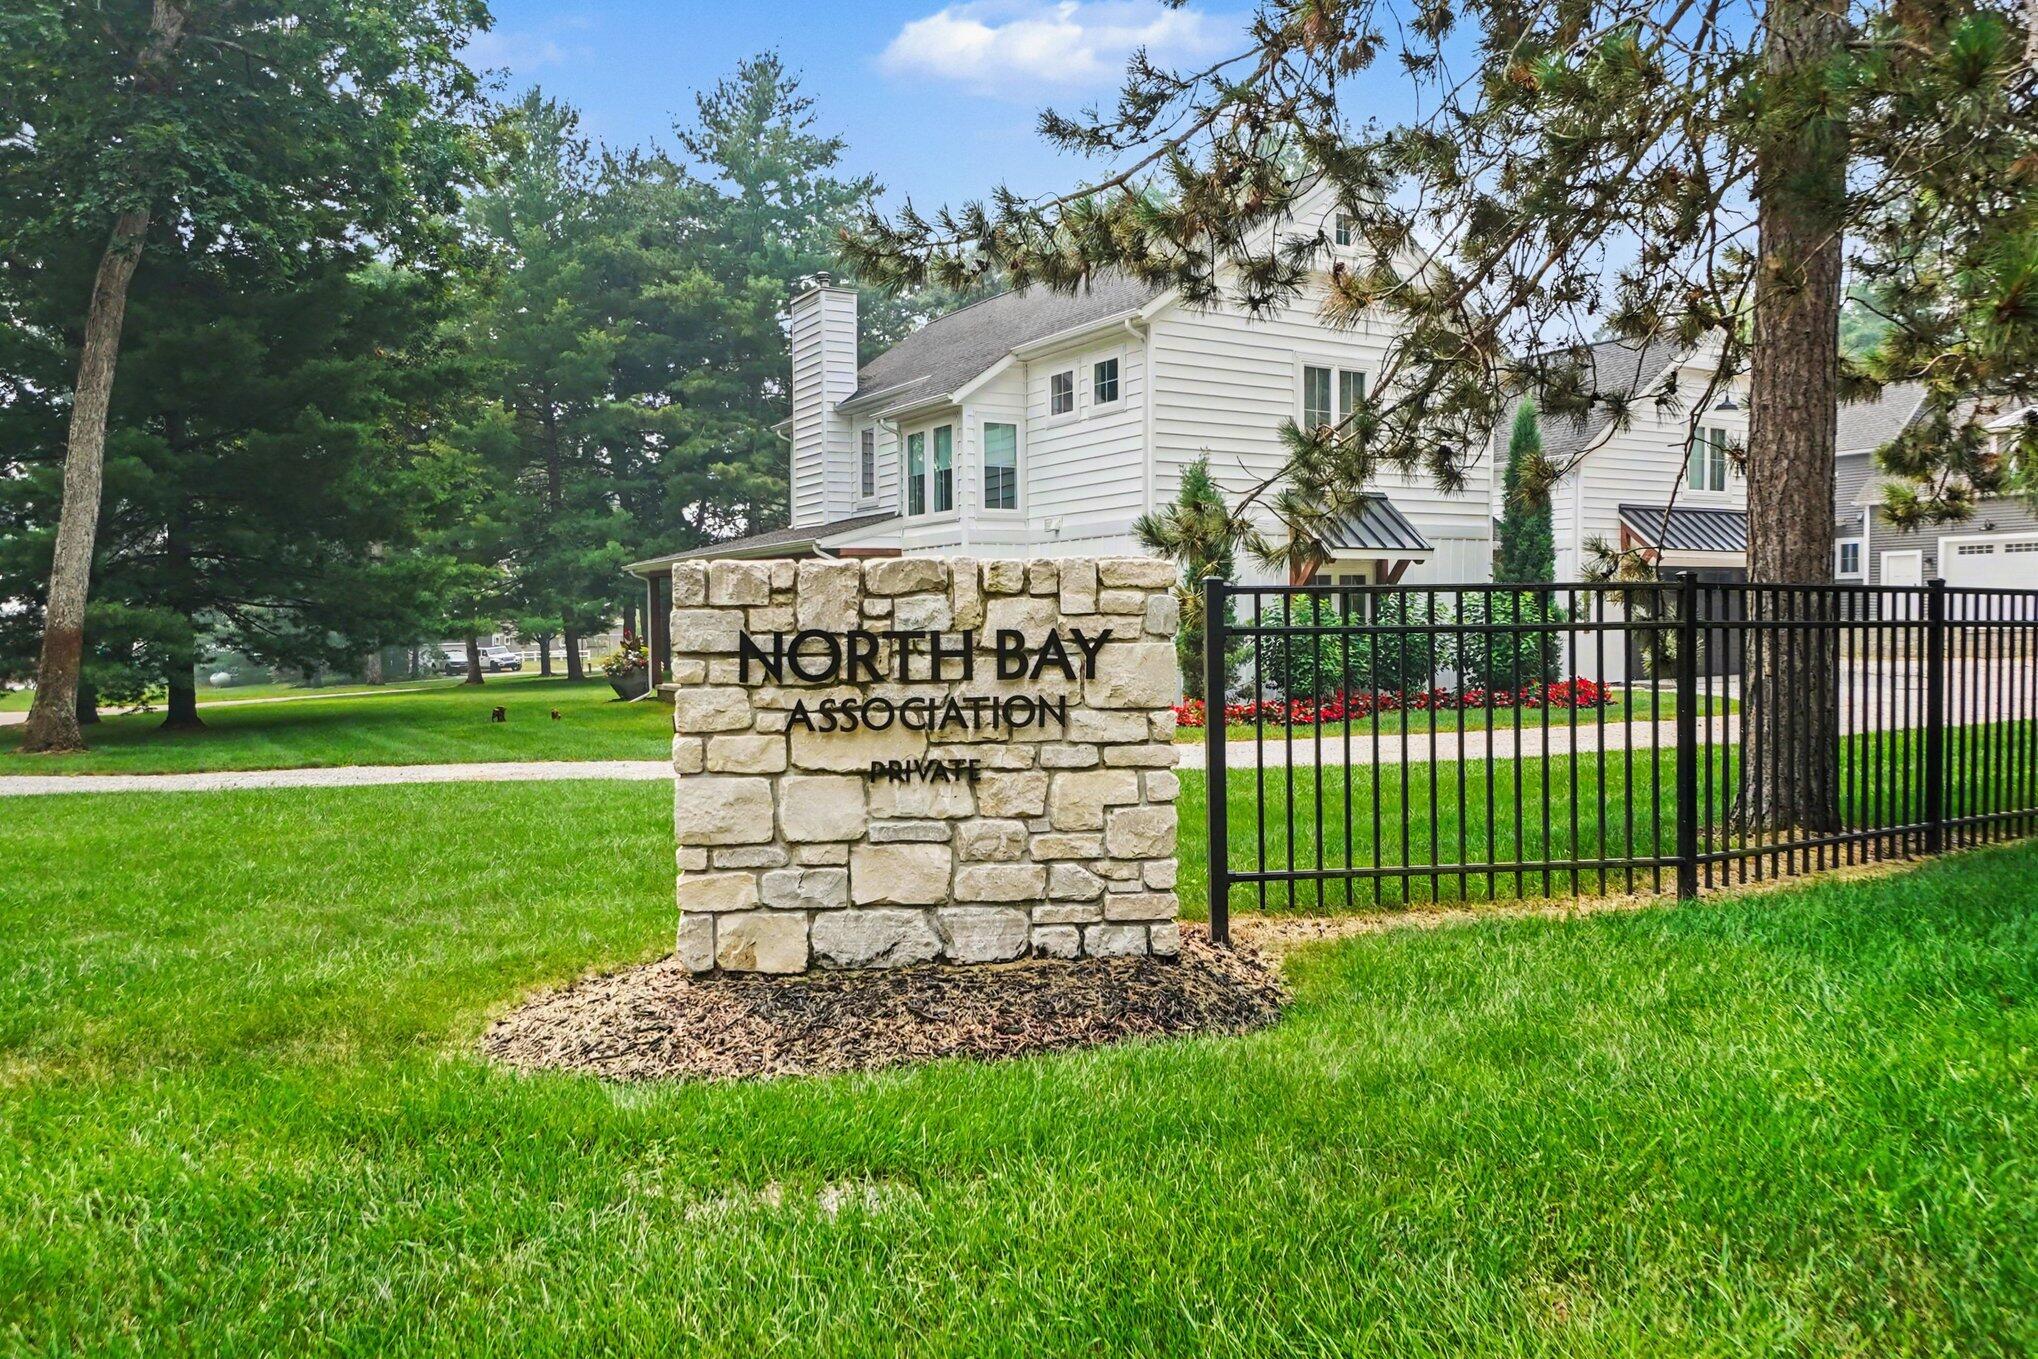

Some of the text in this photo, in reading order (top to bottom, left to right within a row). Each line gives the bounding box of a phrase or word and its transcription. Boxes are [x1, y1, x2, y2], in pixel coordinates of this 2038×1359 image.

[738, 628, 1114, 685] NORTH BAY
[786, 694, 1067, 733] ASSOCIATION
[869, 757, 982, 784] PRIVATE
